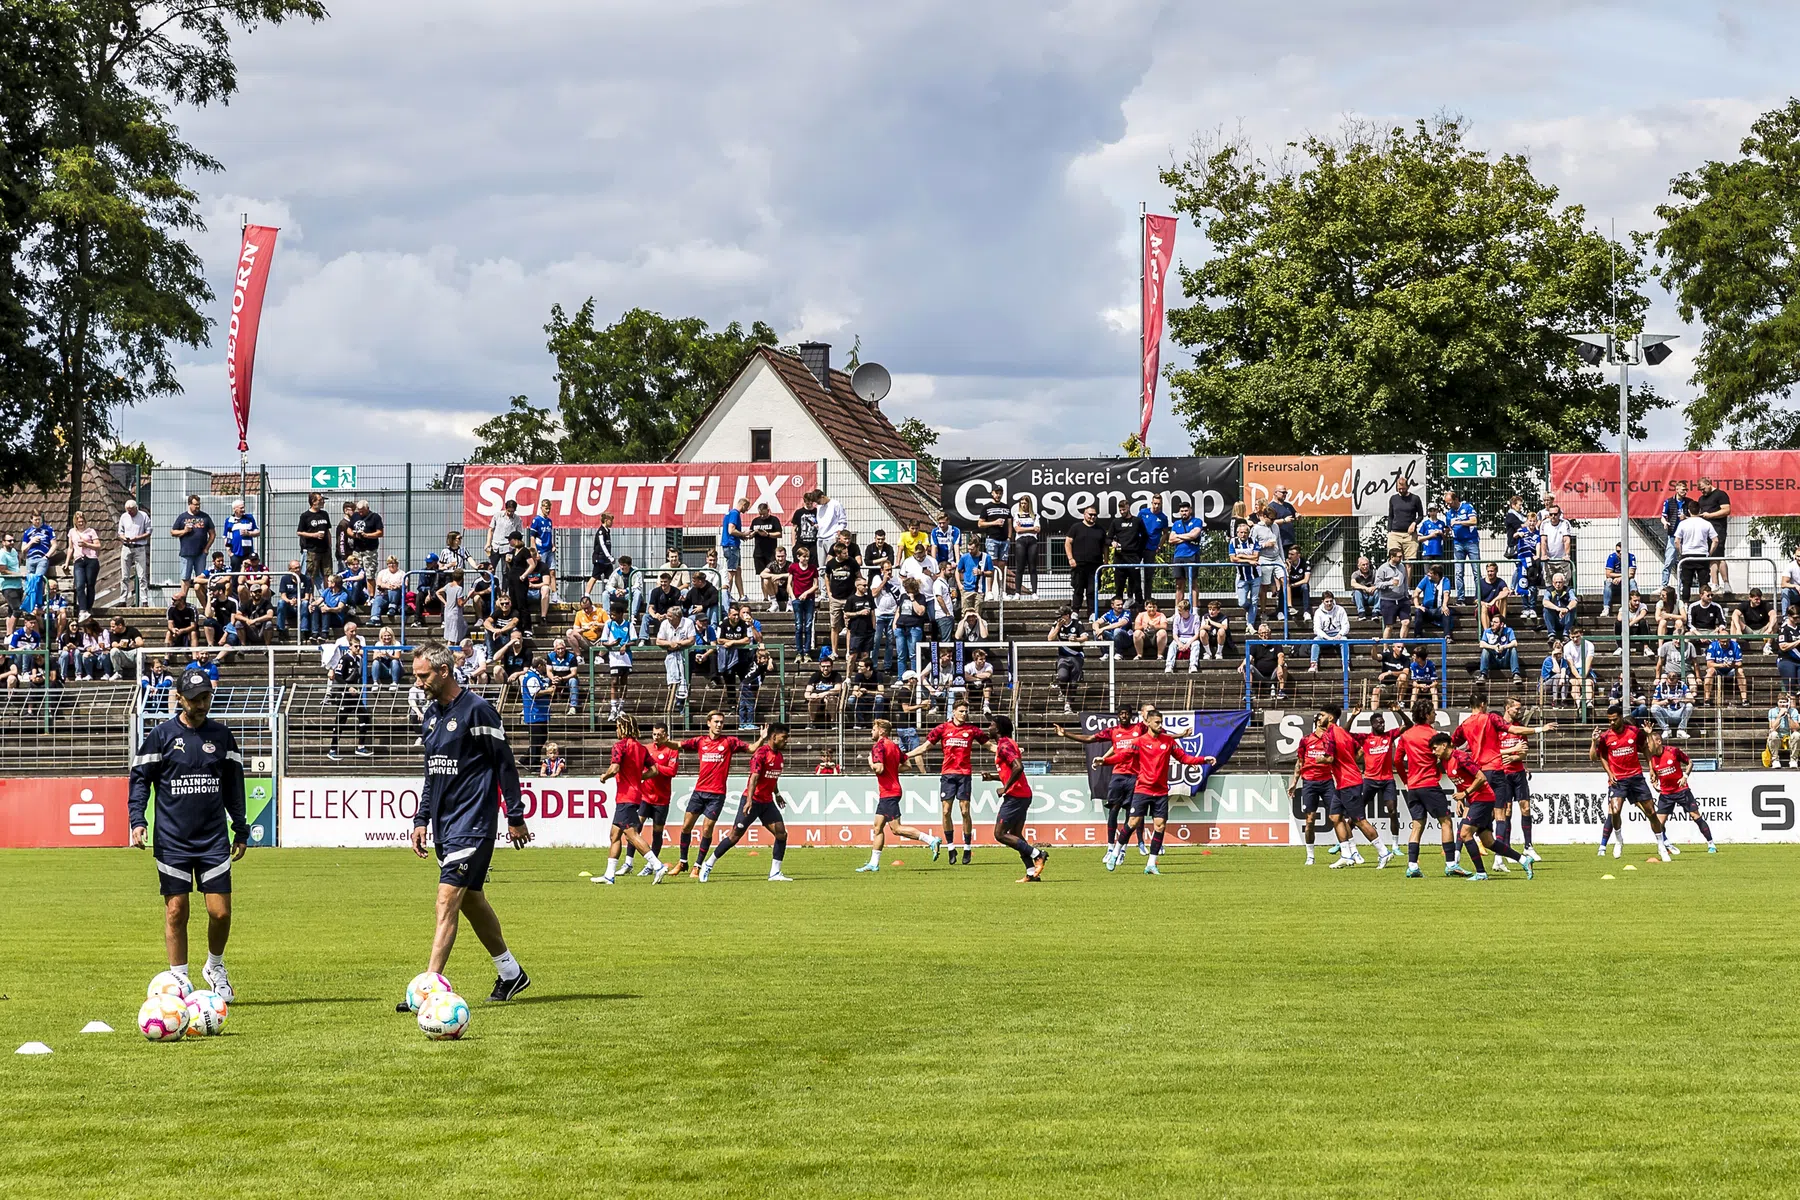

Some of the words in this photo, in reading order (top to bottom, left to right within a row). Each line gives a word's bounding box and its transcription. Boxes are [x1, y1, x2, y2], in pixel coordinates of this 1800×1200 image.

[1247, 461, 1319, 472] Friseursalon
[1031, 467, 1110, 486] Bäckerei
[1127, 467, 1169, 485] Café
[1563, 478, 1664, 493] SCHÜTGUT.
[258, 761, 265, 772] 9
[171, 778, 219, 787] BRAINPORT
[171, 786, 219, 795] EINDHOVEN
[293, 789, 419, 819] ELEKTRO
[1530, 793, 1607, 824] STARK
